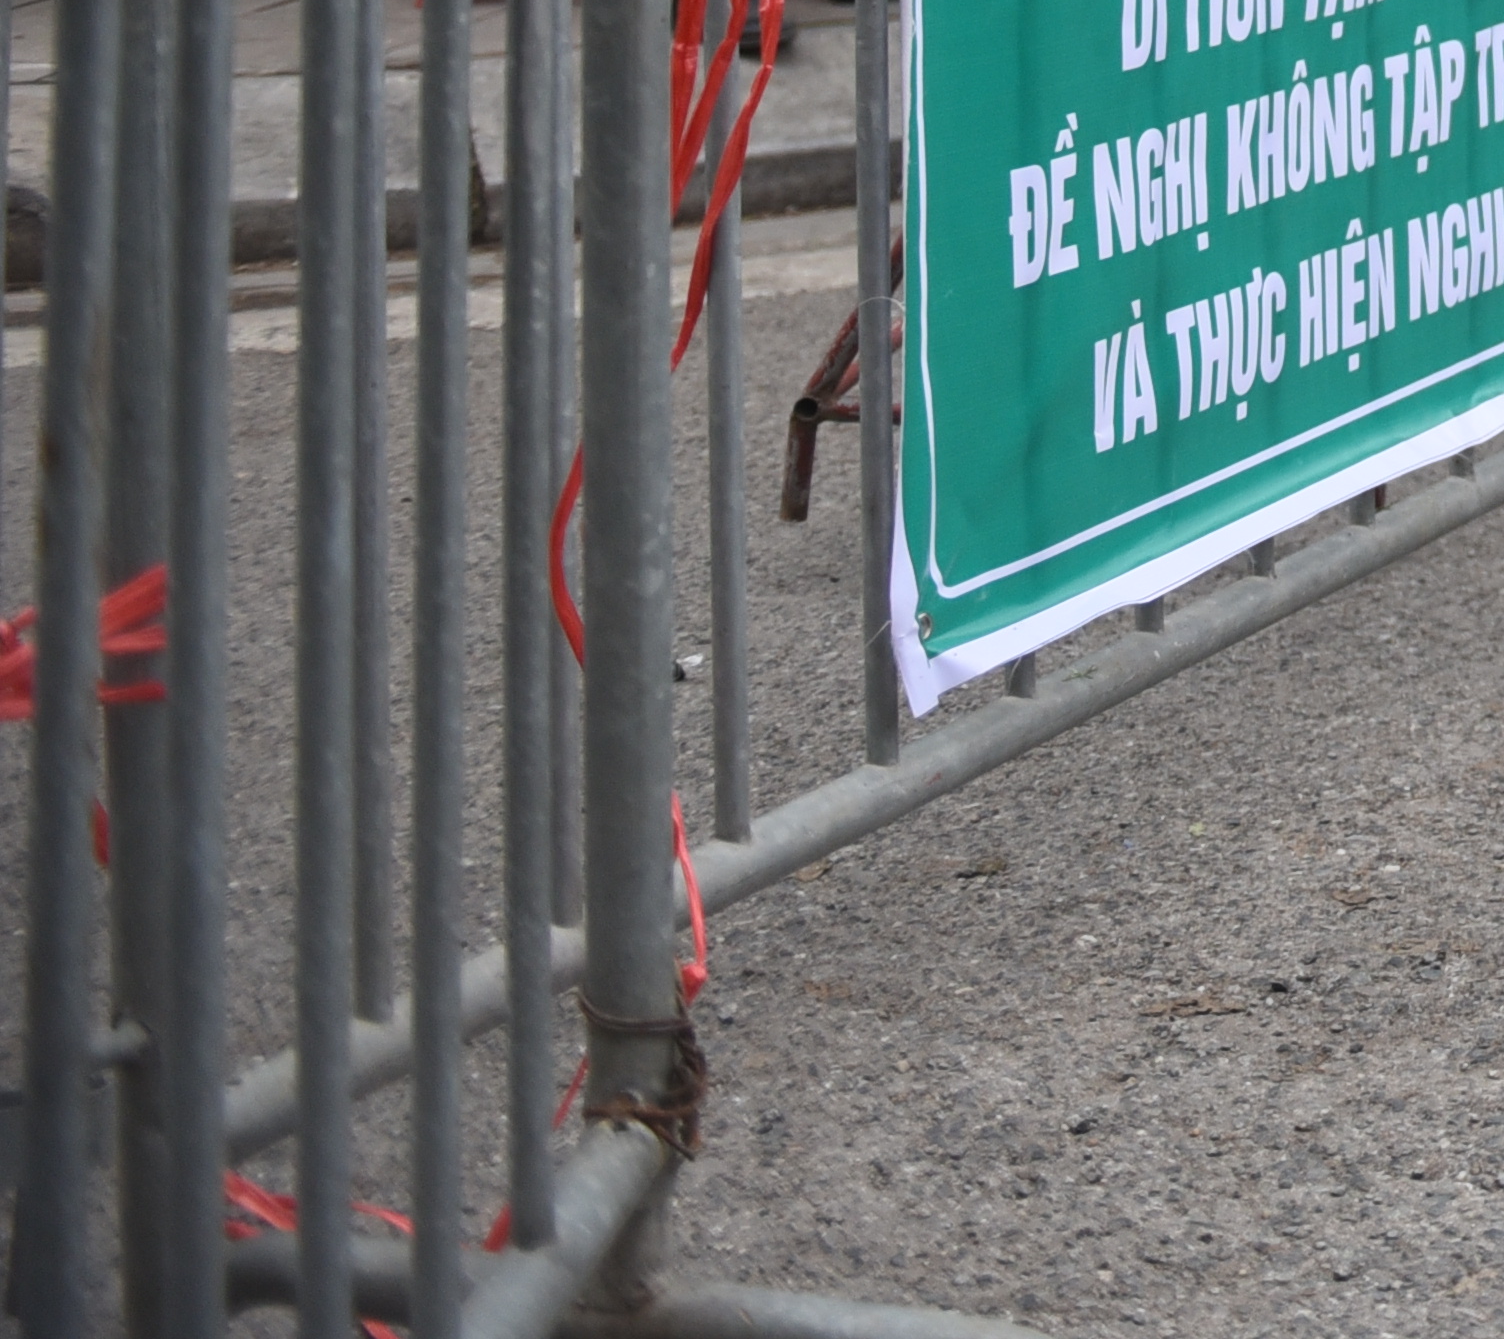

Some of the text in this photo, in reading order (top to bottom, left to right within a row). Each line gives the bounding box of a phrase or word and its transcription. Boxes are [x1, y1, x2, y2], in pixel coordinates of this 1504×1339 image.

[1009, 113, 1079, 288] ĐỀ
[1094, 113, 1208, 259] NGHỊ
[1227, 60, 1374, 214] KHÔNG
[1384, 31, 1465, 172] TẬP
[1094, 300, 1157, 452] VÀ
[1166, 267, 1286, 420] THỰC
[1300, 218, 1395, 371] HIỆN
